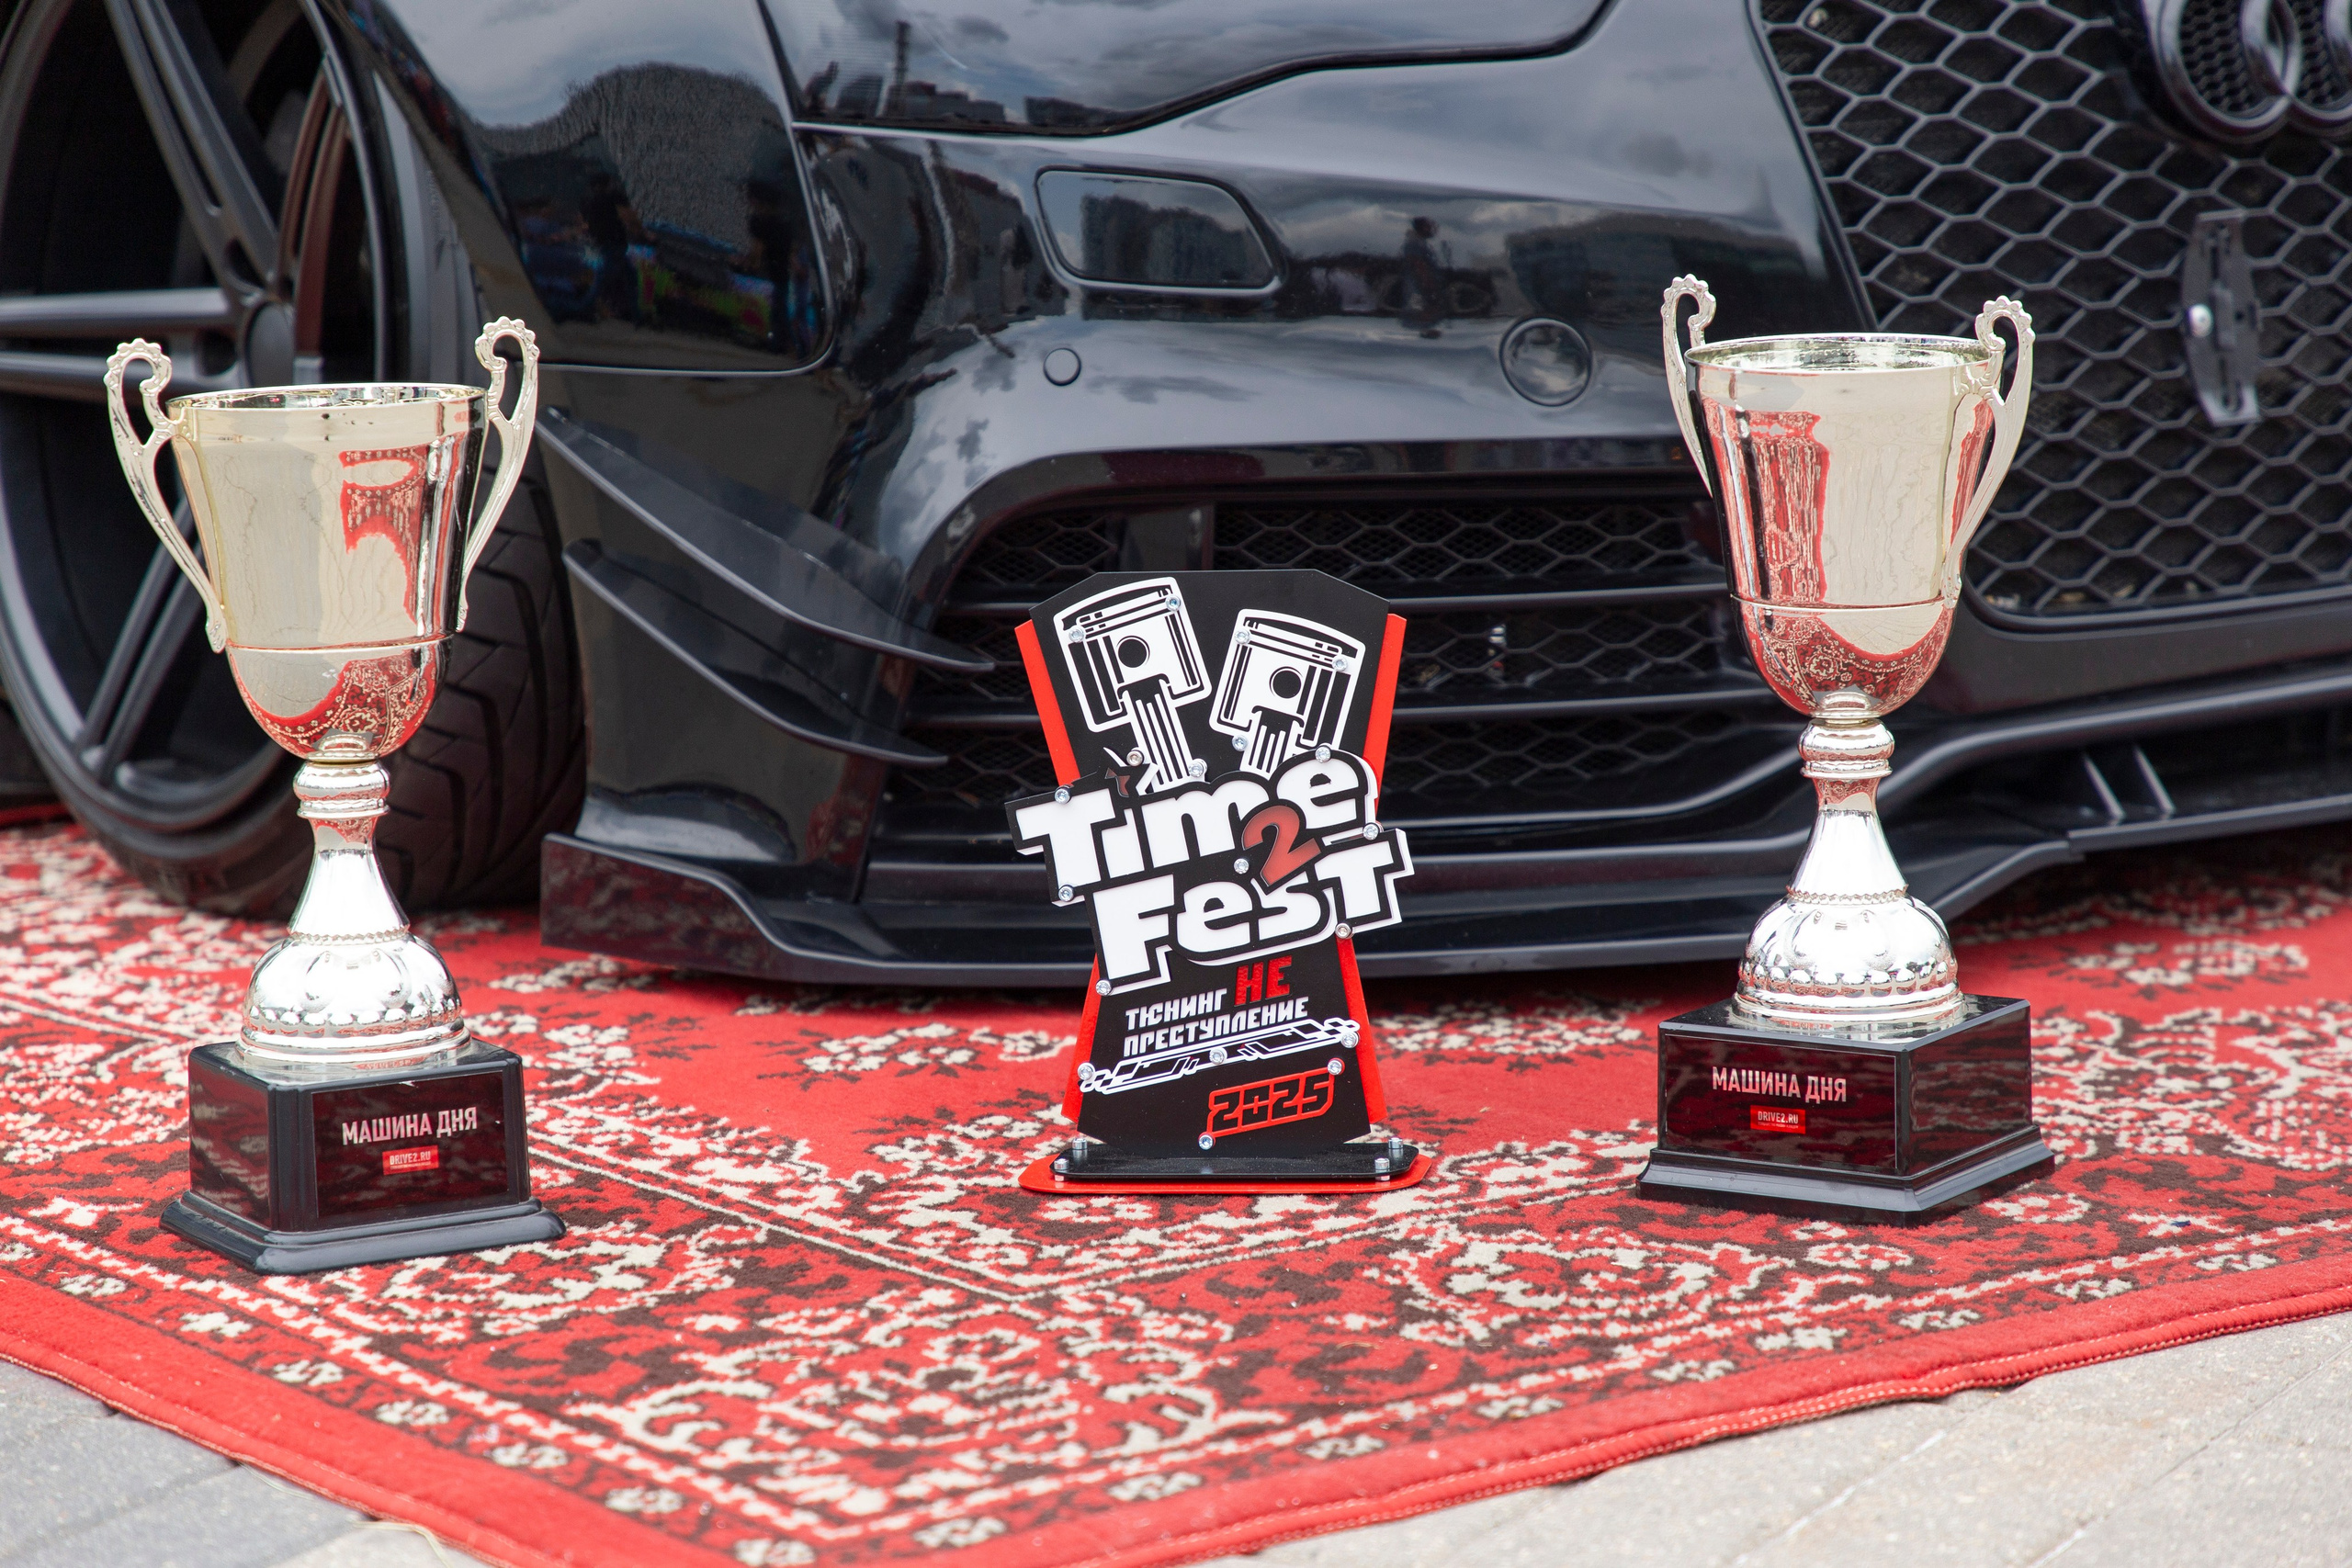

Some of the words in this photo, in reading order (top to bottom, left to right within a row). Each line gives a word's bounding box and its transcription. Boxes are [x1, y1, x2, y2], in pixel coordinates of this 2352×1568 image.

[1015, 757, 1360, 889] Time
[1242, 805, 1320, 886] 2
[1125, 988, 1227, 1031] ТЮНИНГ
[1234, 955, 1293, 1007] НЕ
[1123, 997, 1309, 1057] ПРЕСТУПЛЕНИЕ
[1209, 1068, 1334, 1135] 2025
[1713, 1066, 1801, 1098] МАШИНА
[1804, 1075, 1847, 1104] ДНЯ
[342, 1112, 433, 1145] МАШИНА
[436, 1107, 478, 1138] ДНЯ
[1758, 1111, 1799, 1124] DRIVE2.RU
[390, 1151, 431, 1165] DRIVE2.RU
